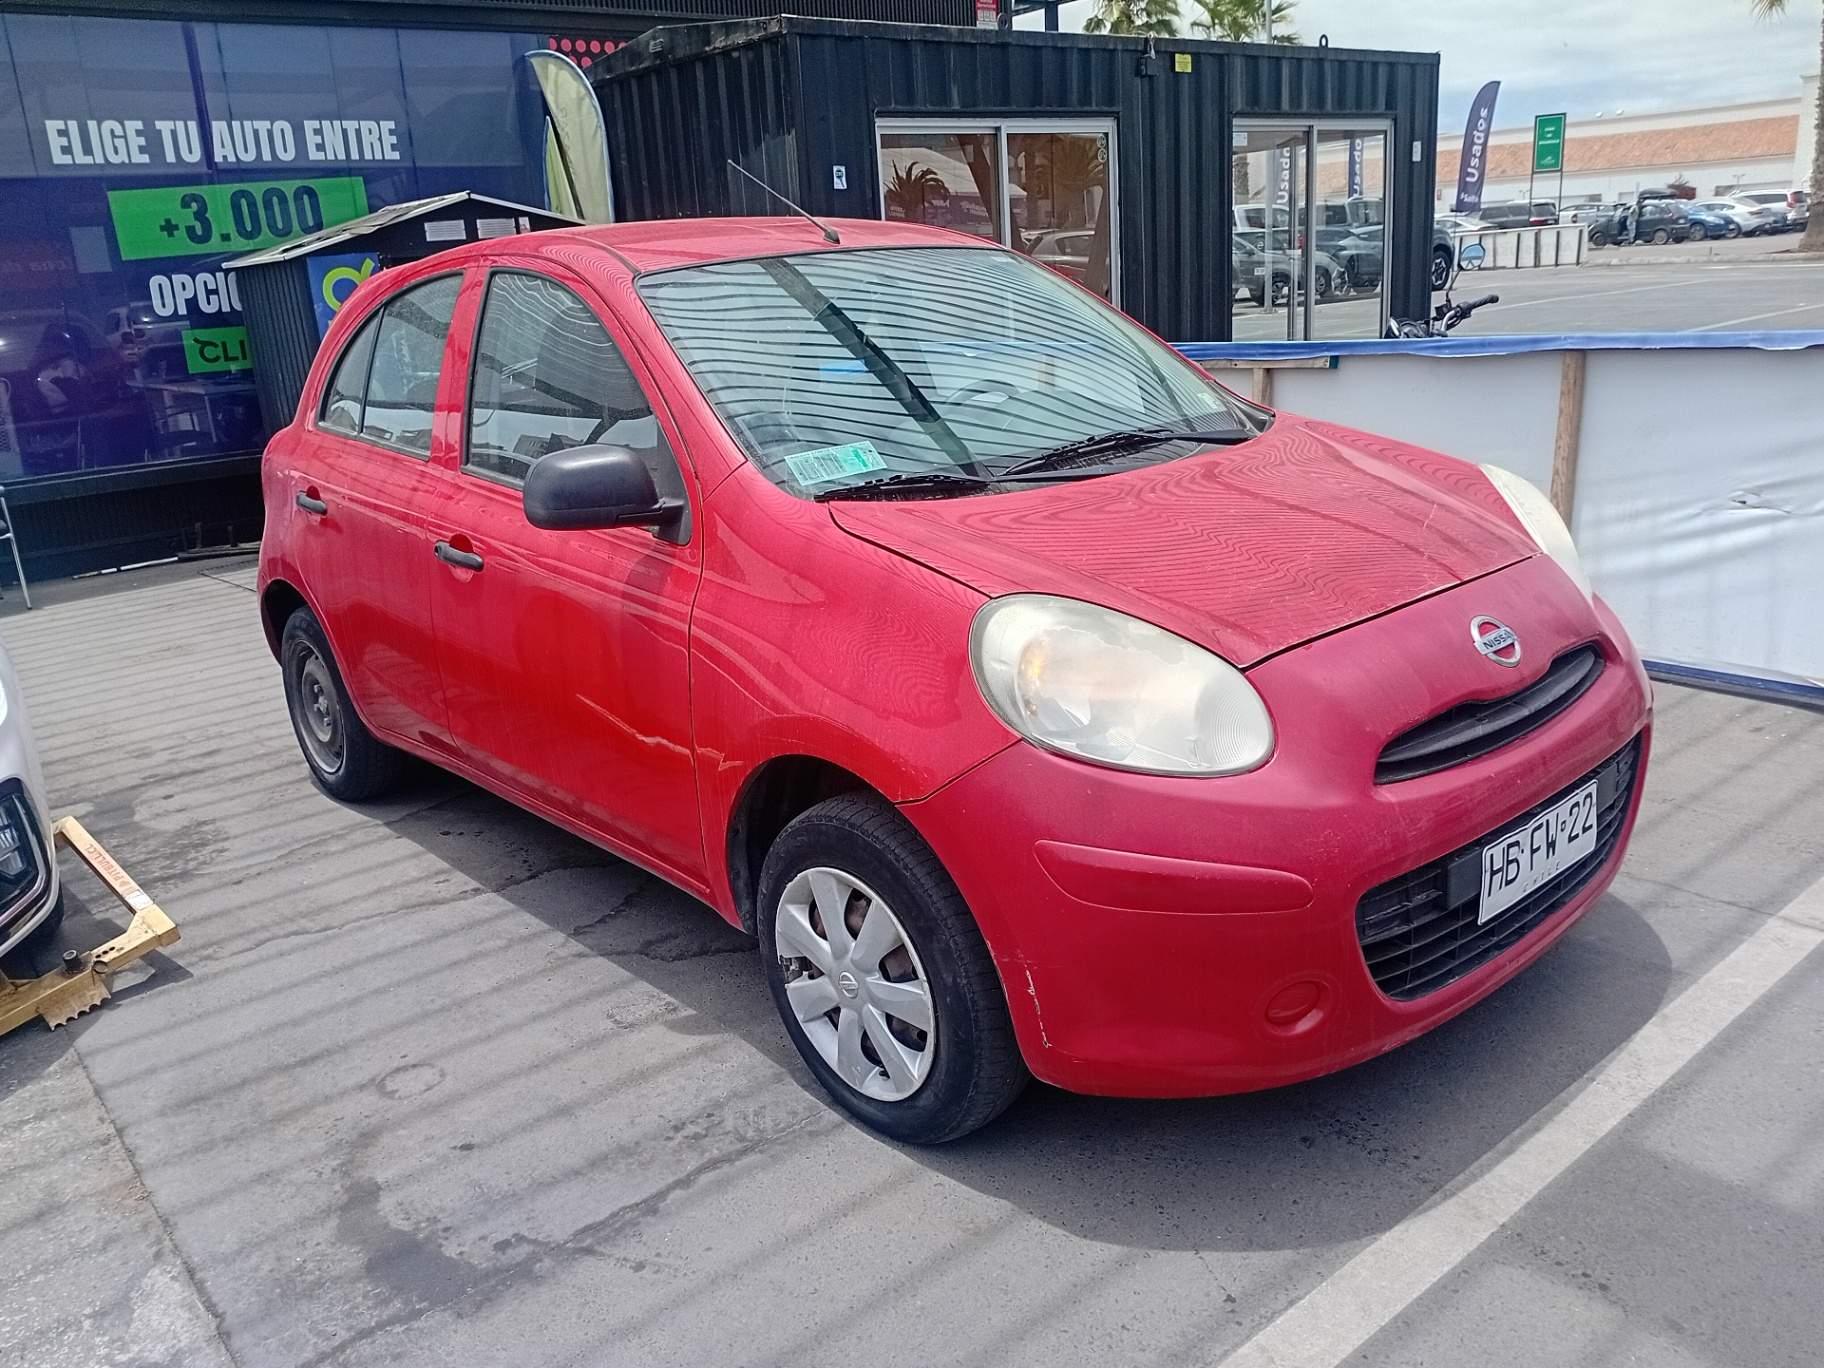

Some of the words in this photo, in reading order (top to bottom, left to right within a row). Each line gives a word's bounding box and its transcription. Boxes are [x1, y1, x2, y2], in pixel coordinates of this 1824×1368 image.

[44, 119, 151, 165] ELIGE
[154, 119, 201, 164] TU
[211, 119, 296, 162] AUTO
[303, 119, 401, 161] ENTRE
[1465, 106, 1489, 183] Usados
[159, 184, 324, 245] +3.000
